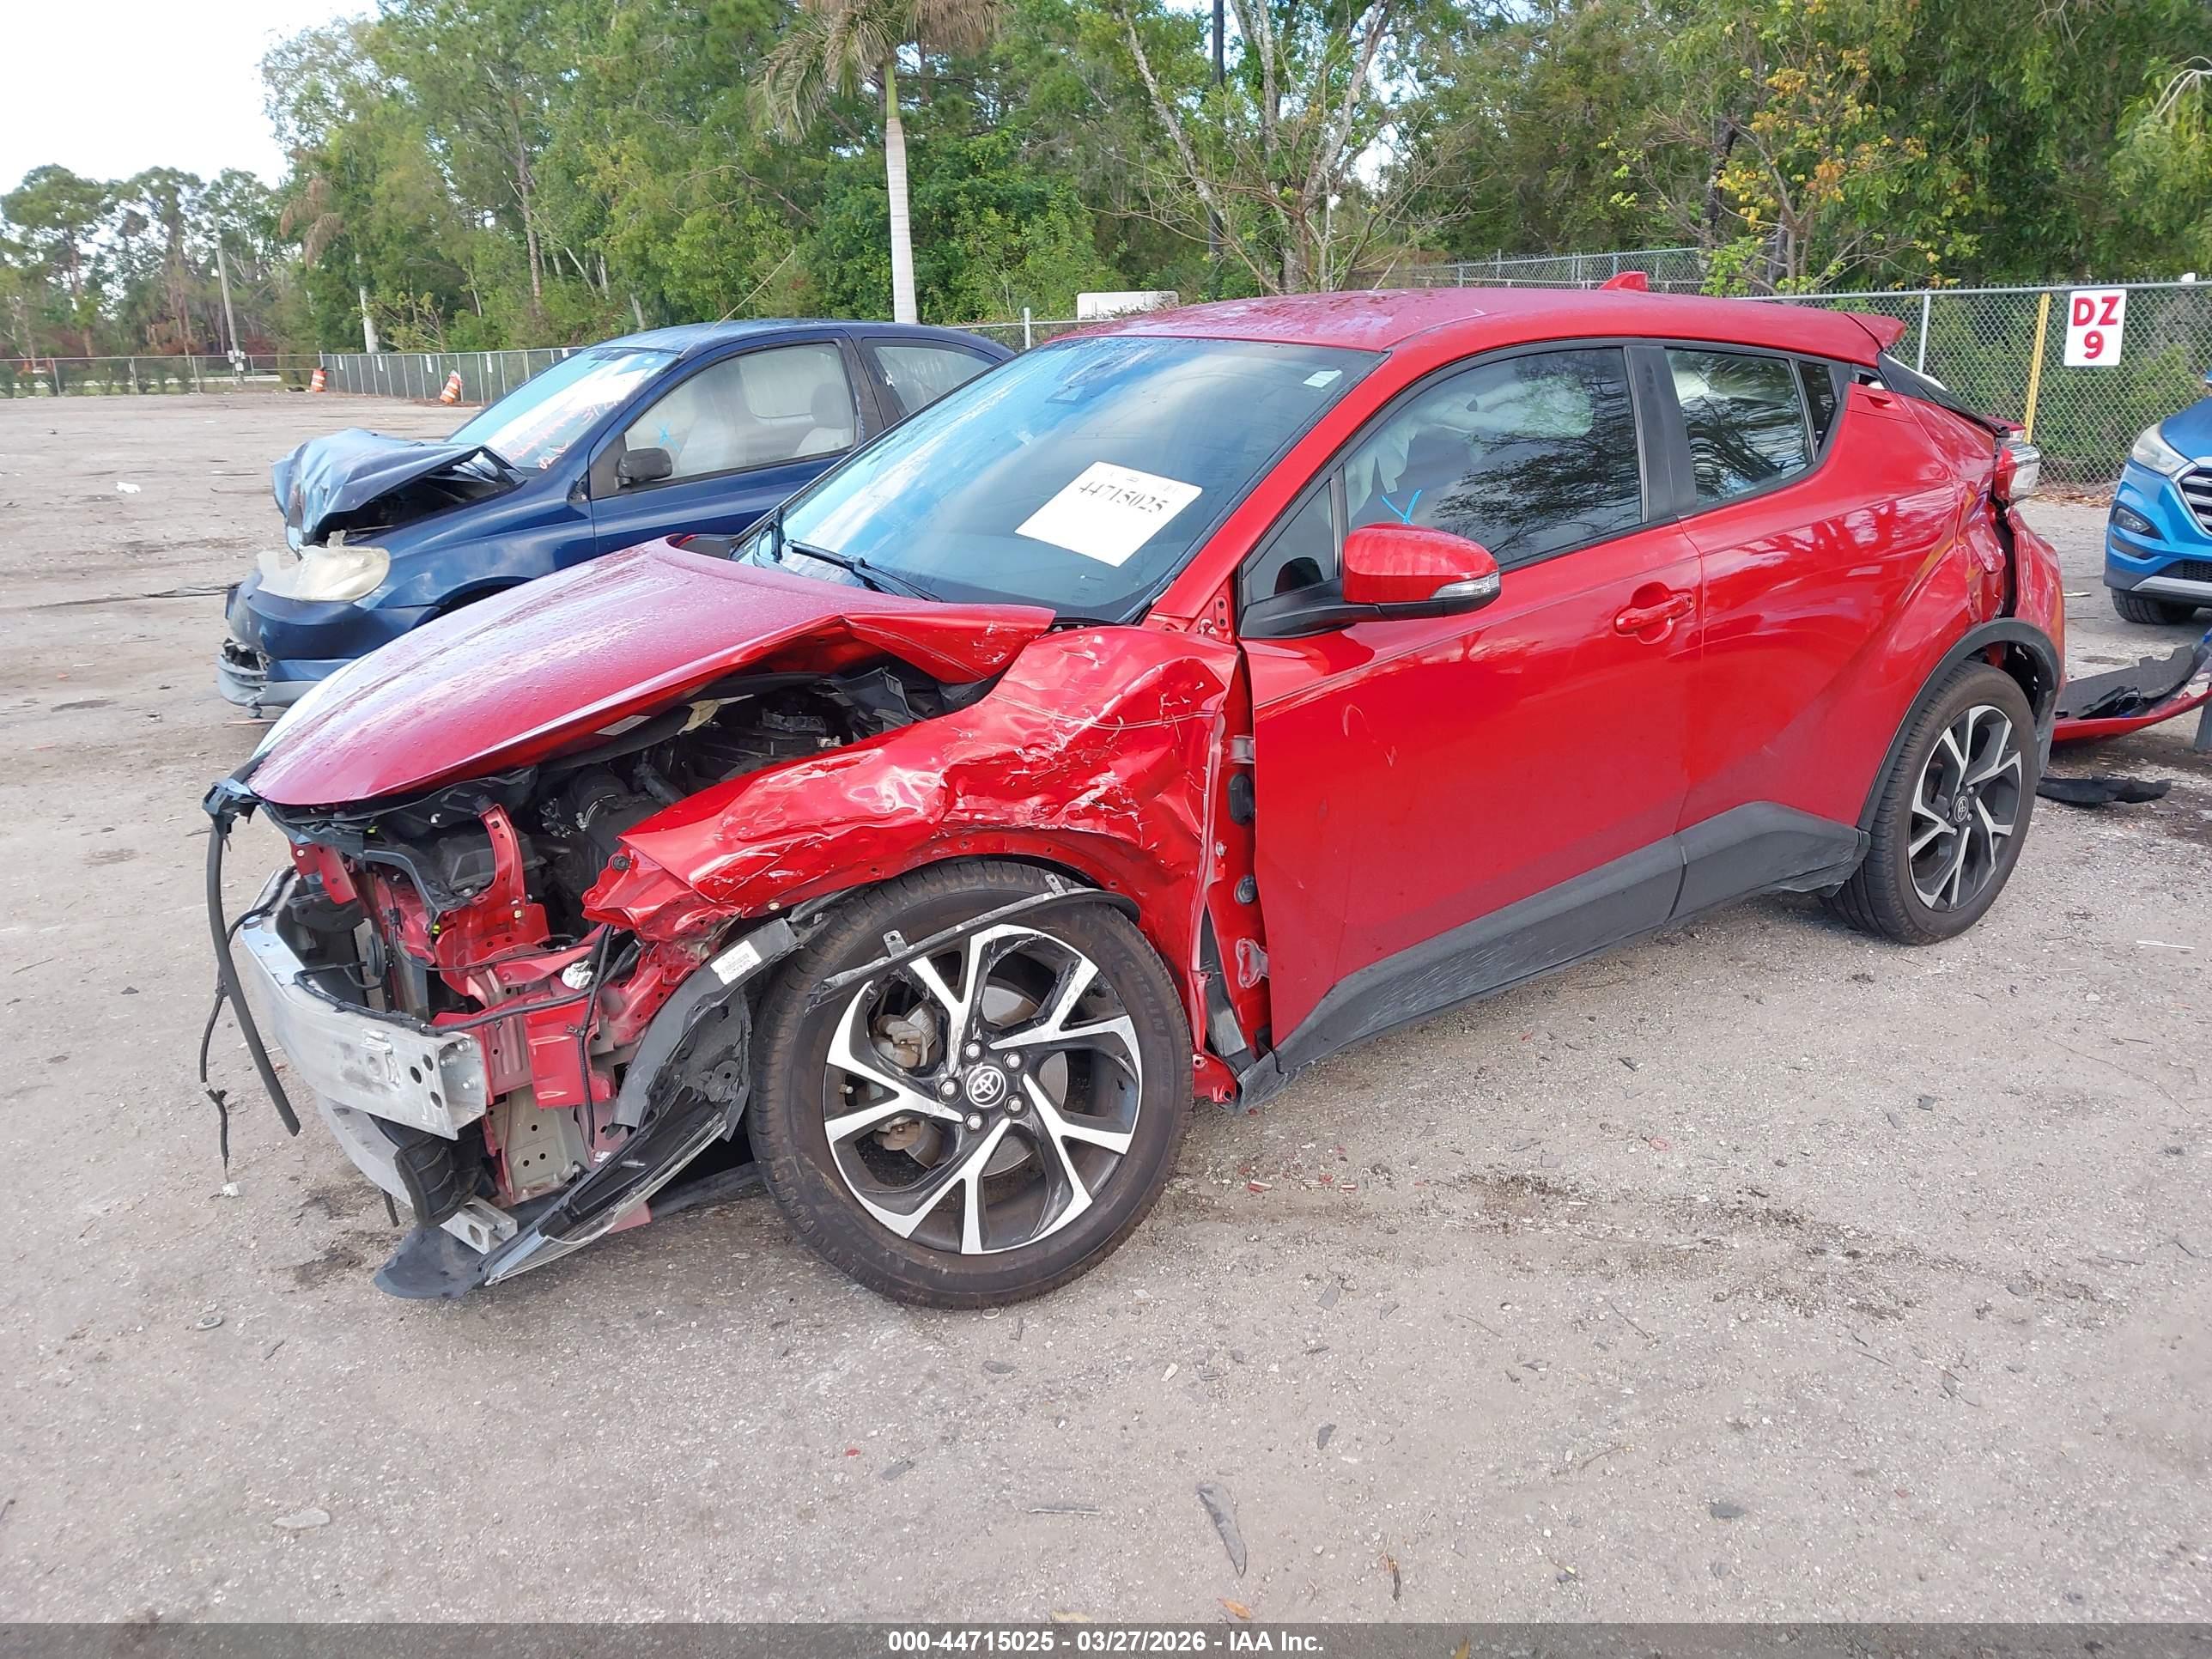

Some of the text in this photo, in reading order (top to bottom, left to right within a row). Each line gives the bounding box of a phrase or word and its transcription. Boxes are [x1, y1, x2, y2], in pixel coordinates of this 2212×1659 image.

[2072, 295, 2123, 327] DZ
[2083, 330, 2105, 359] 9
[1078, 480, 1170, 514] 44715025
